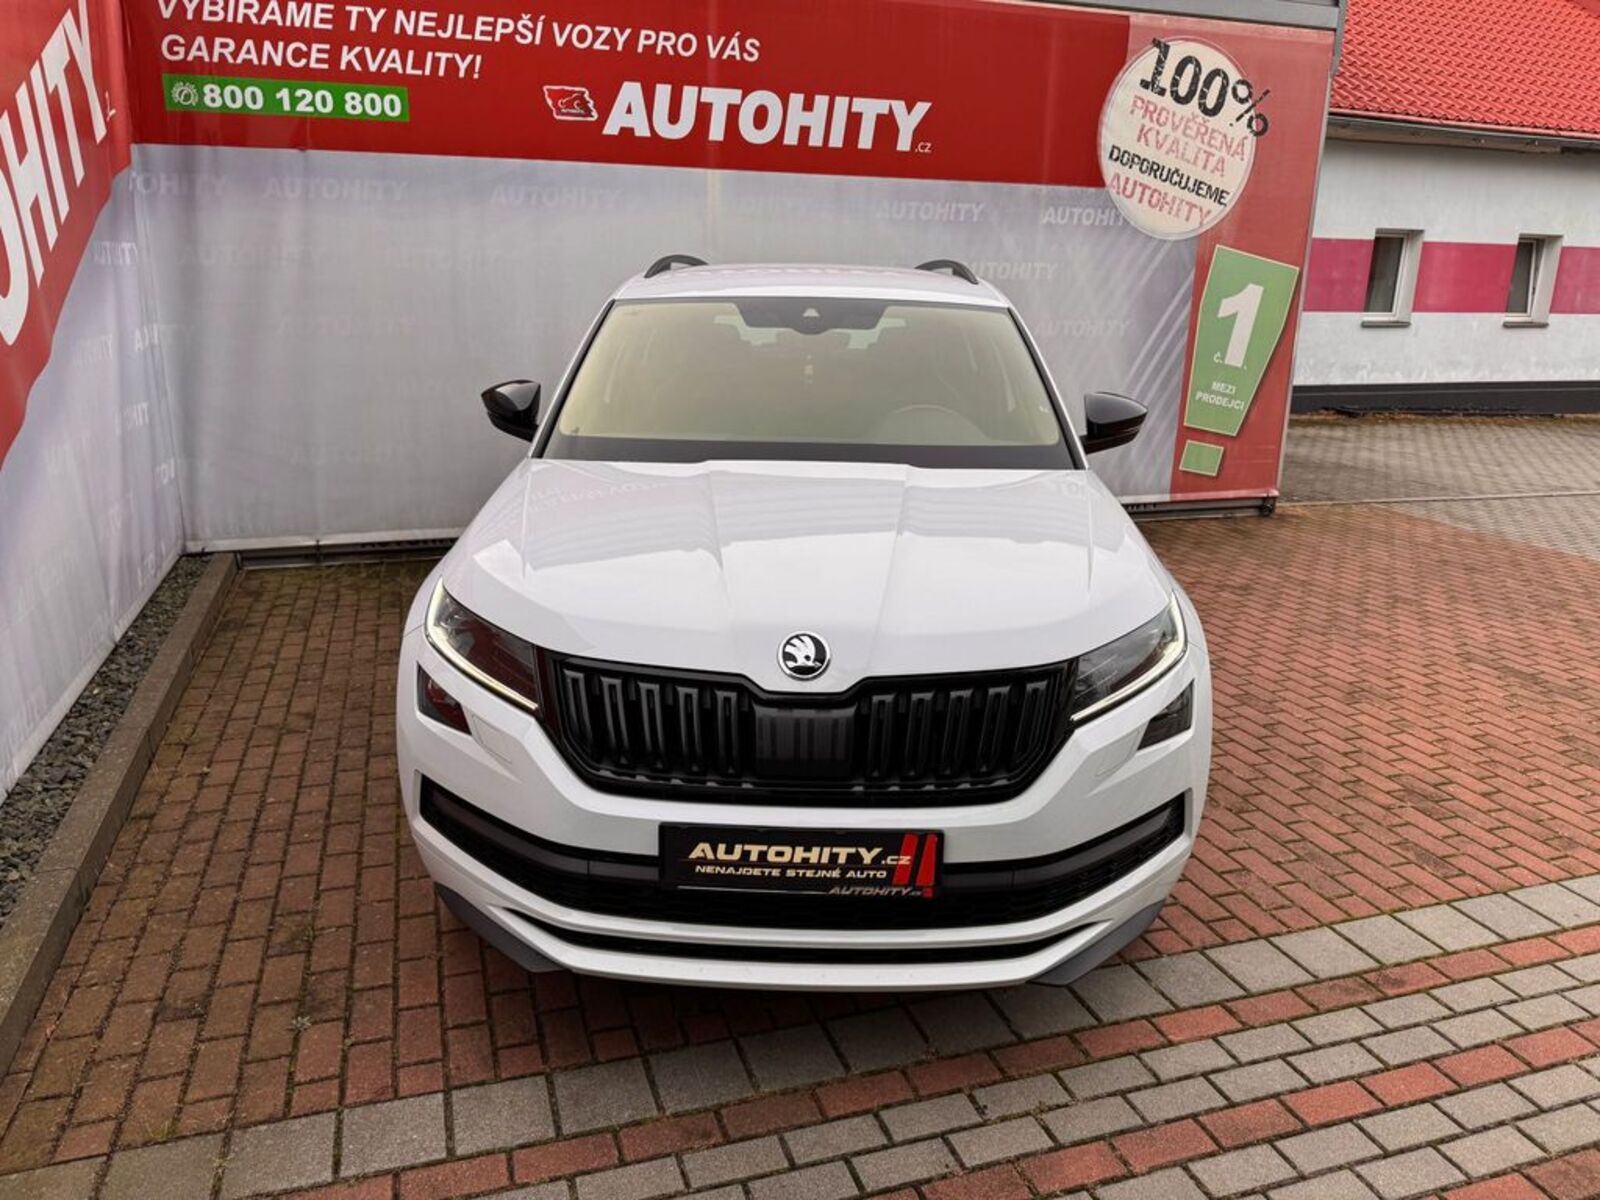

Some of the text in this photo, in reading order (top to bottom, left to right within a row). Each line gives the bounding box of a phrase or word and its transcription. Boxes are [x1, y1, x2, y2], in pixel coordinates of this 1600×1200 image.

[161, 34, 482, 79] GARANCE KVALITY!
[345, 6, 387, 33] TY
[393, 9, 545, 46] NEJLEPŠÍ
[552, 22, 631, 54] VOZY
[637, 30, 697, 57] PRO
[706, 33, 761, 62] VÁS
[203, 84, 402, 117] 800 120 800
[1139, 37, 1270, 137] 100%
[1129, 94, 1249, 161] PROVĚŘENÁ
[1136, 123, 1226, 178] KVALITA
[1108, 145, 1231, 206] DOPORUČUJEME
[1110, 172, 1213, 224] AUTOHITY
[877, 200, 985, 222] AUTOHITY
[1195, 391, 1246, 410] PRODEJCI
[1211, 381, 1237, 395] MEZI
[695, 865, 887, 879] NENAJDETE STEJNÉ AUTO
